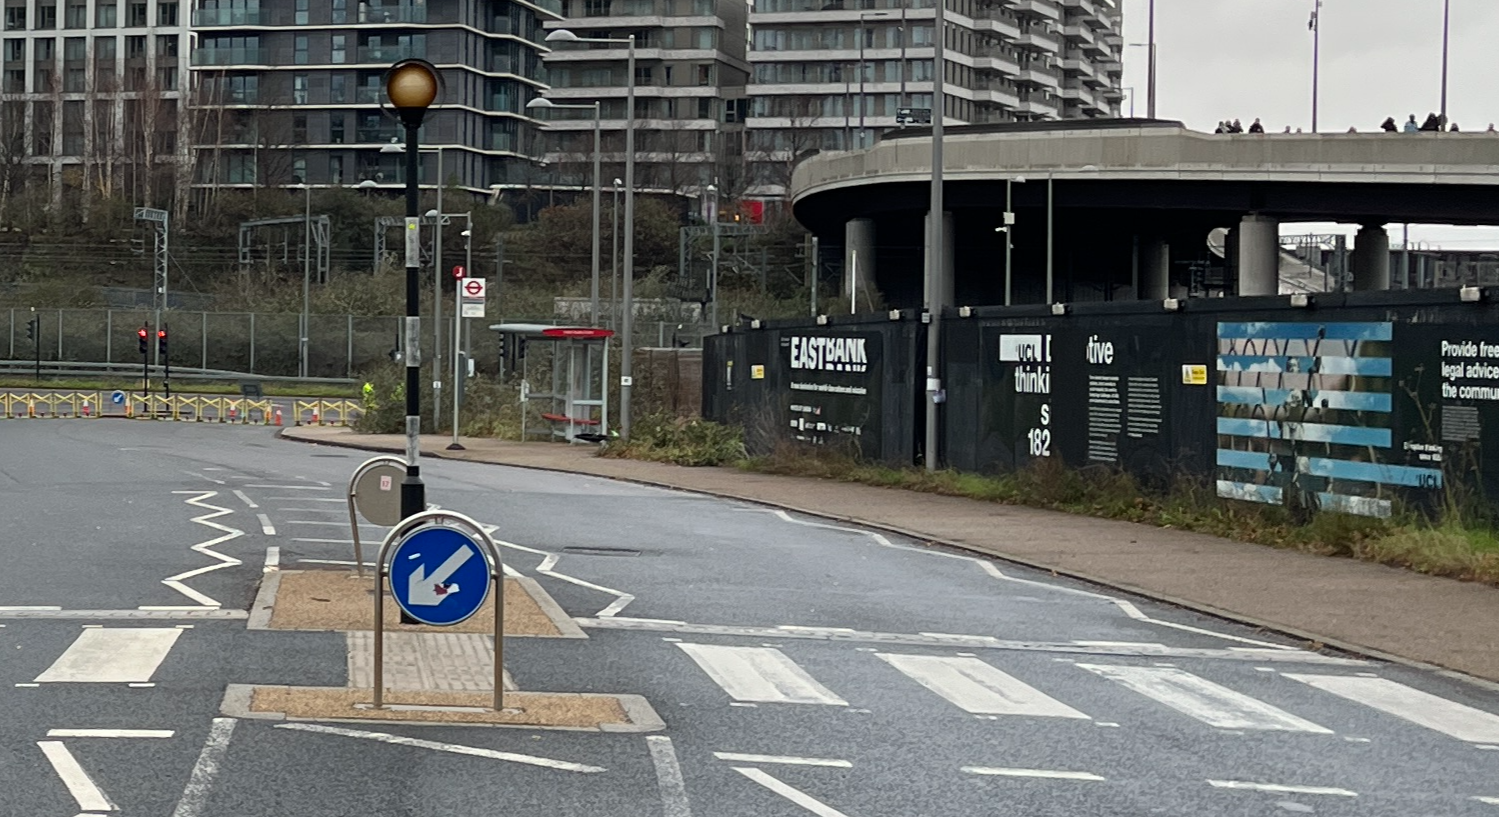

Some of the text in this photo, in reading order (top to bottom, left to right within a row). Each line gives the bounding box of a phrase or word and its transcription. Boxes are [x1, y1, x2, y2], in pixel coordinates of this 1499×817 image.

[456, 267, 463, 277] J
[1087, 334, 1114, 364] tive
[1441, 340, 1499, 358] Provide free
[1014, 365, 1050, 394] thinki
[1441, 361, 1499, 381] legal advice
[1442, 382, 1457, 398] the
[1027, 428, 1051, 456] 182
